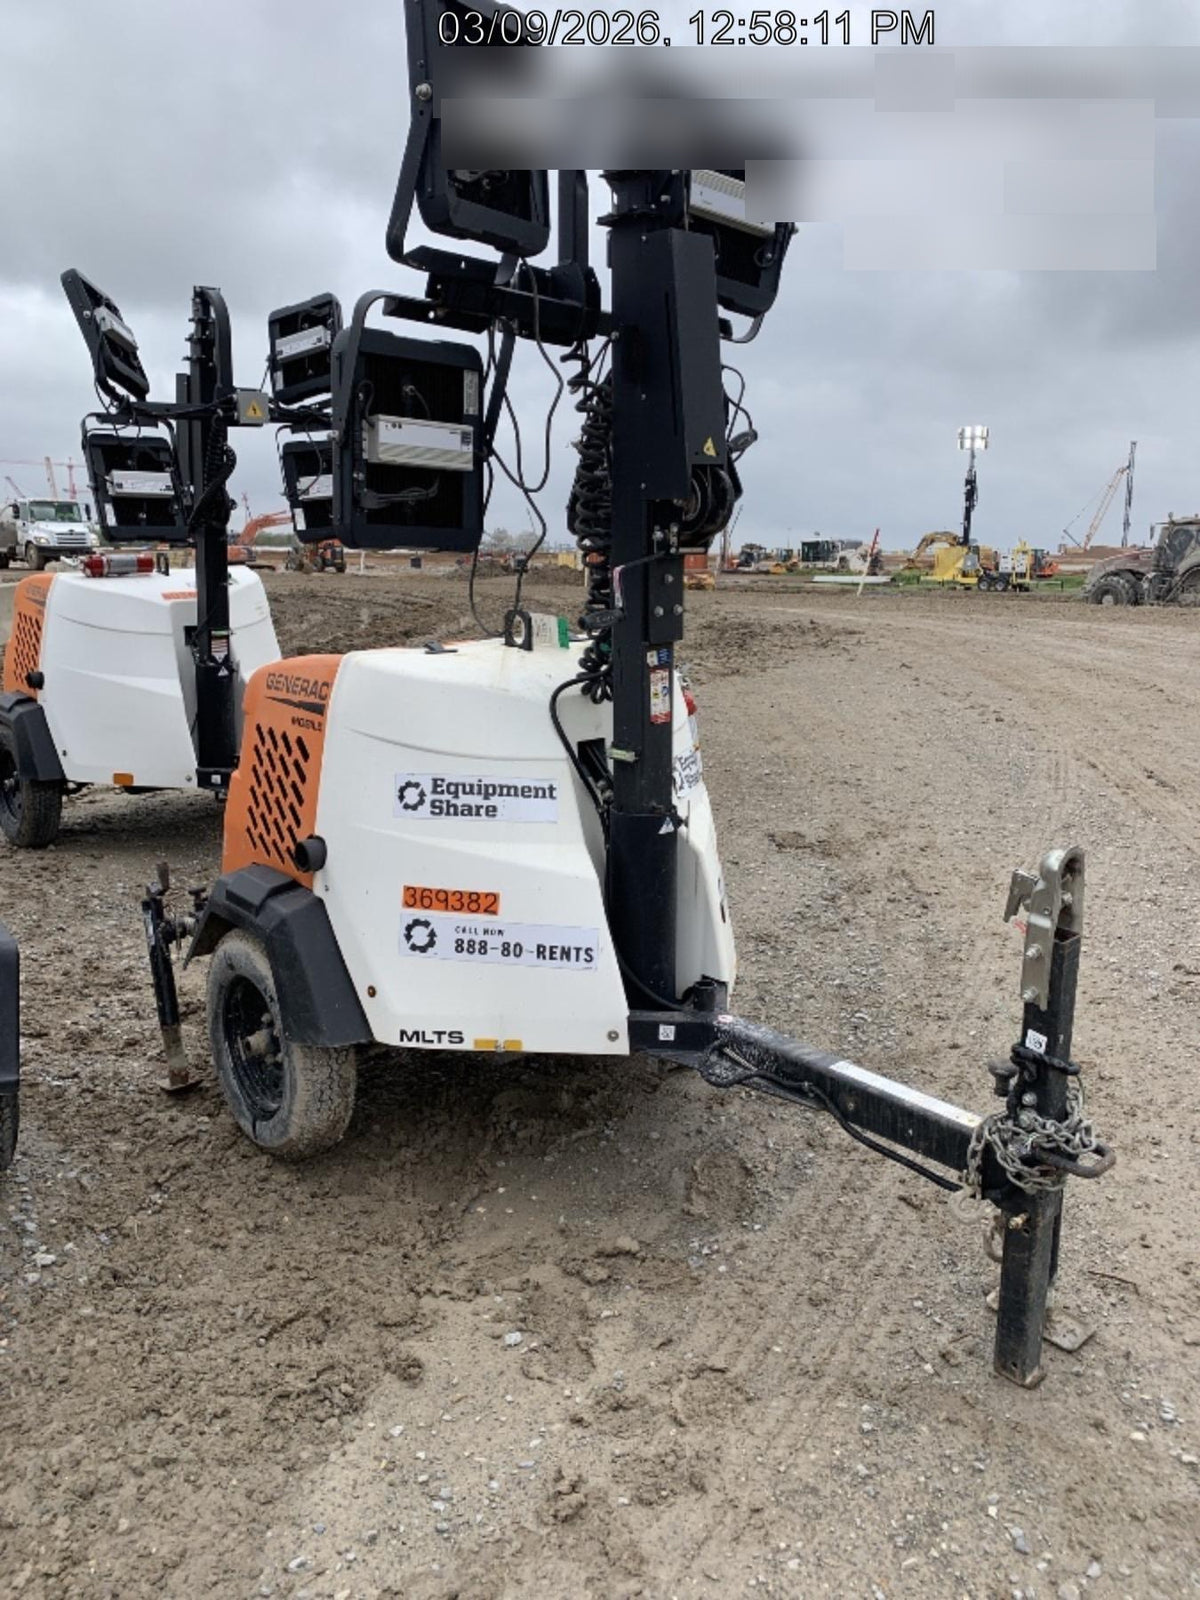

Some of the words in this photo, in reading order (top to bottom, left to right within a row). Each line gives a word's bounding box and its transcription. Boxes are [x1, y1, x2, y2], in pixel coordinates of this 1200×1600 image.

[266, 673, 330, 701] GENERAC
[430, 777, 557, 800] Equipment
[430, 799, 498, 818] Share
[403, 886, 499, 915] 369382
[455, 938, 594, 963] 888-80-RENTS
[400, 1030, 465, 1044] MLTS
